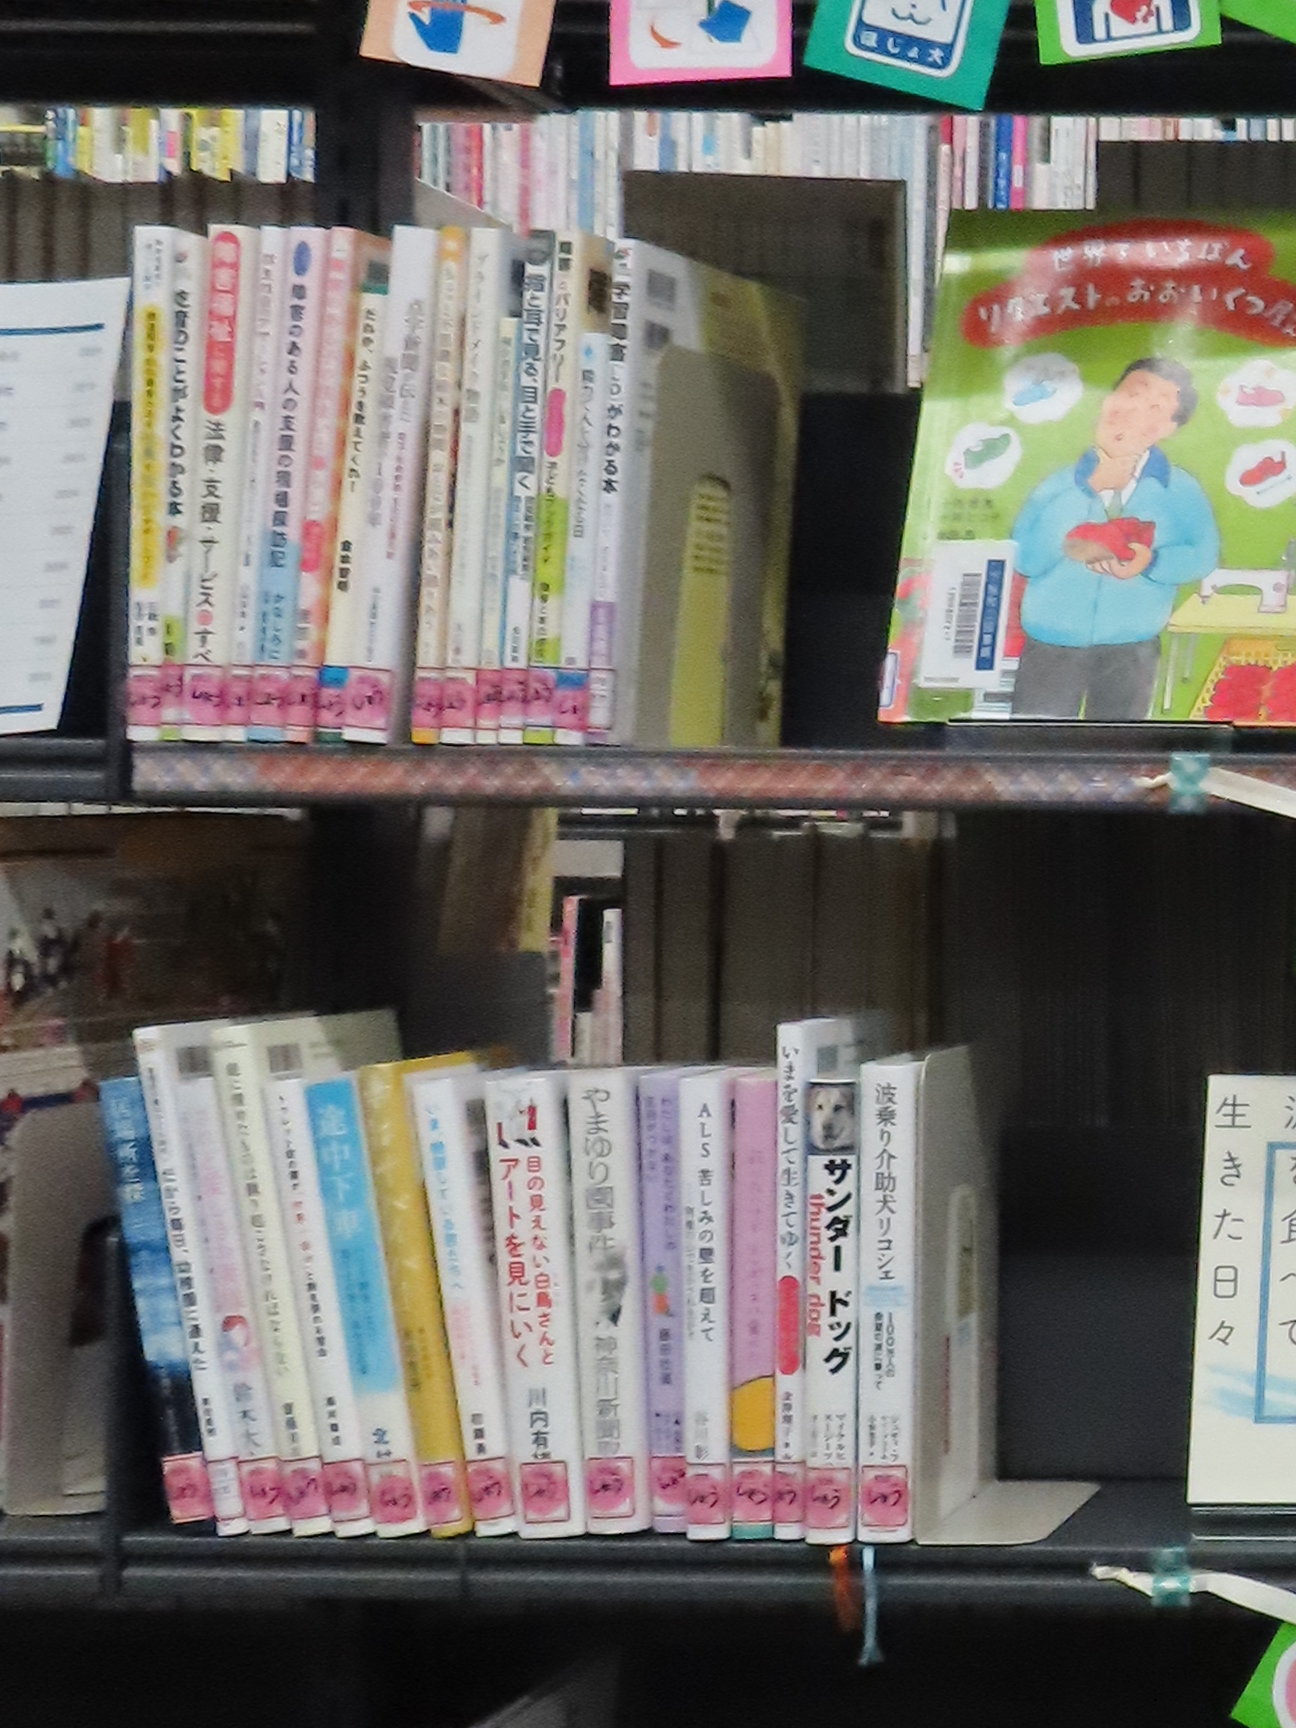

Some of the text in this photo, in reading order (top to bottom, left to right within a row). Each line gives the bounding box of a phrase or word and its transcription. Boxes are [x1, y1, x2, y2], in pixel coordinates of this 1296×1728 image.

[582, 1088, 616, 1254] やまゆり園事件
[697, 1102, 712, 1159] ALS
[779, 1045, 801, 1270] いまを愛して生きてゆく
[874, 1081, 899, 1281] 波乗り介助犬リコシェ
[1207, 1094, 1253, 1347] 生きた日々
[498, 1157, 535, 1369] アートを見にいく
[526, 1156, 556, 1368] 目の見えない白鳥さんと
[806, 1192, 827, 1339] thunder dog
[824, 1158, 853, 1375] サンダー ドッグ
